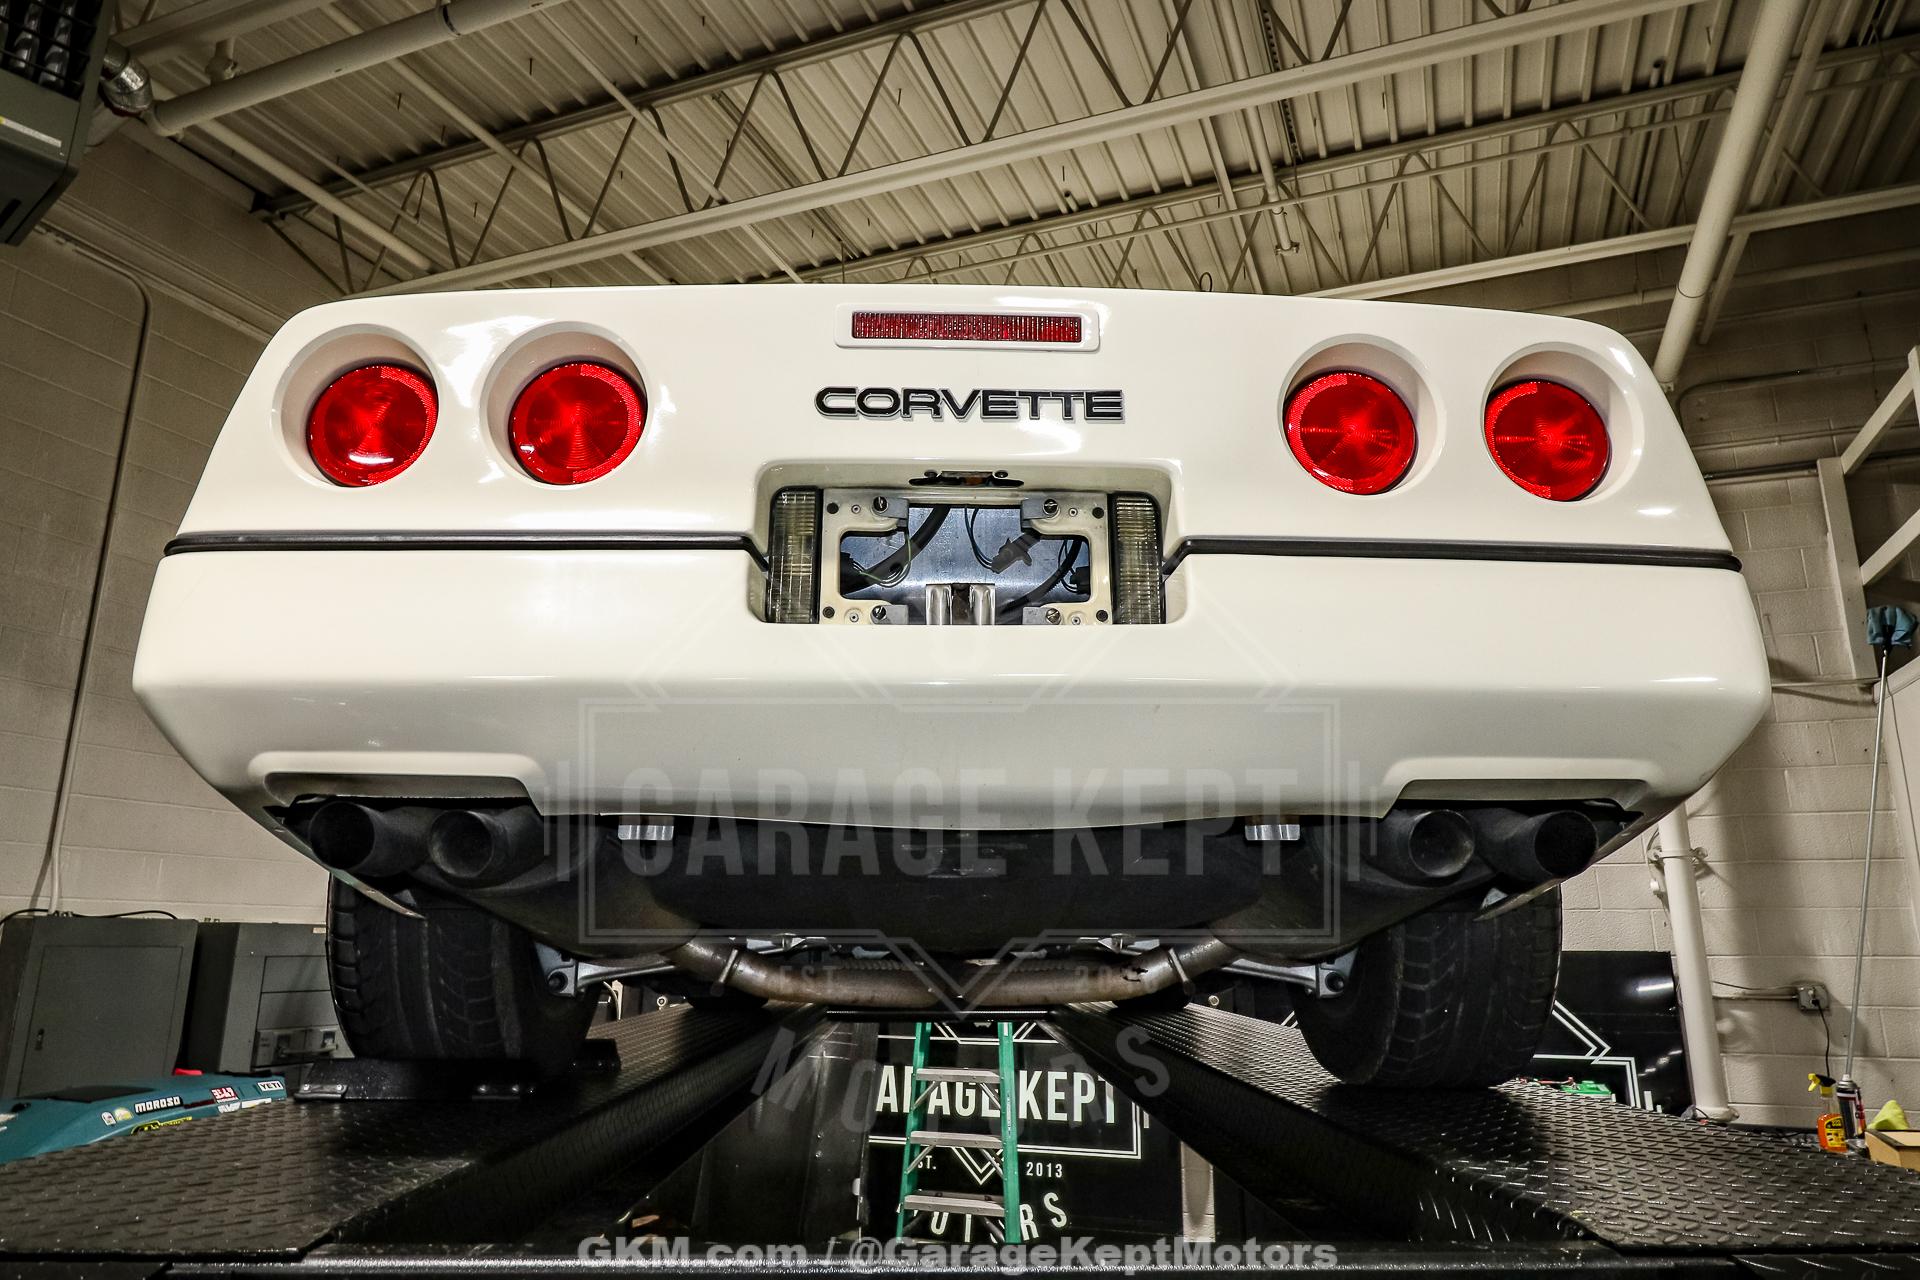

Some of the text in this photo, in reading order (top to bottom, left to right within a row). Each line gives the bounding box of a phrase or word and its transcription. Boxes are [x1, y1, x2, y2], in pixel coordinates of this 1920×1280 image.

[814, 387, 1124, 420] CORVETTE
[260, 1082, 282, 1091] YETI
[134, 1096, 181, 1113] MOROSO
[1026, 1162, 1063, 1179] 2013
